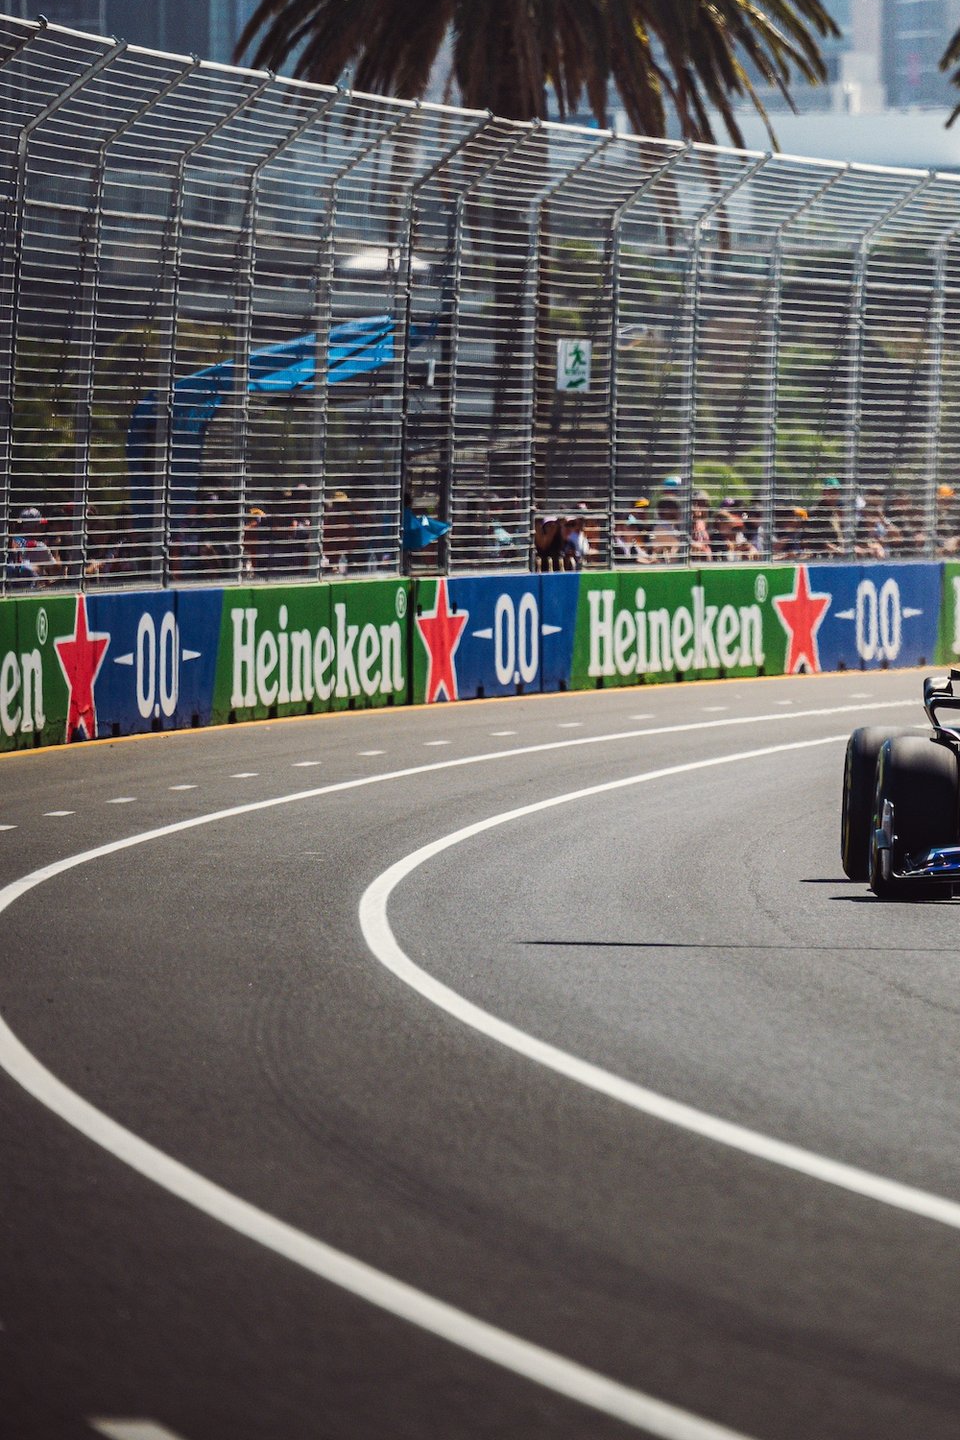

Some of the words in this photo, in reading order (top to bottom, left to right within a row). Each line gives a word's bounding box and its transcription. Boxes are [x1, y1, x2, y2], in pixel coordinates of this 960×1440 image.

[136, 611, 179, 718] 0.0
[230, 602, 405, 709] Heineken
[494, 592, 540, 685] 0.0
[588, 585, 764, 678] Heineken
[855, 578, 902, 661] 0.0
